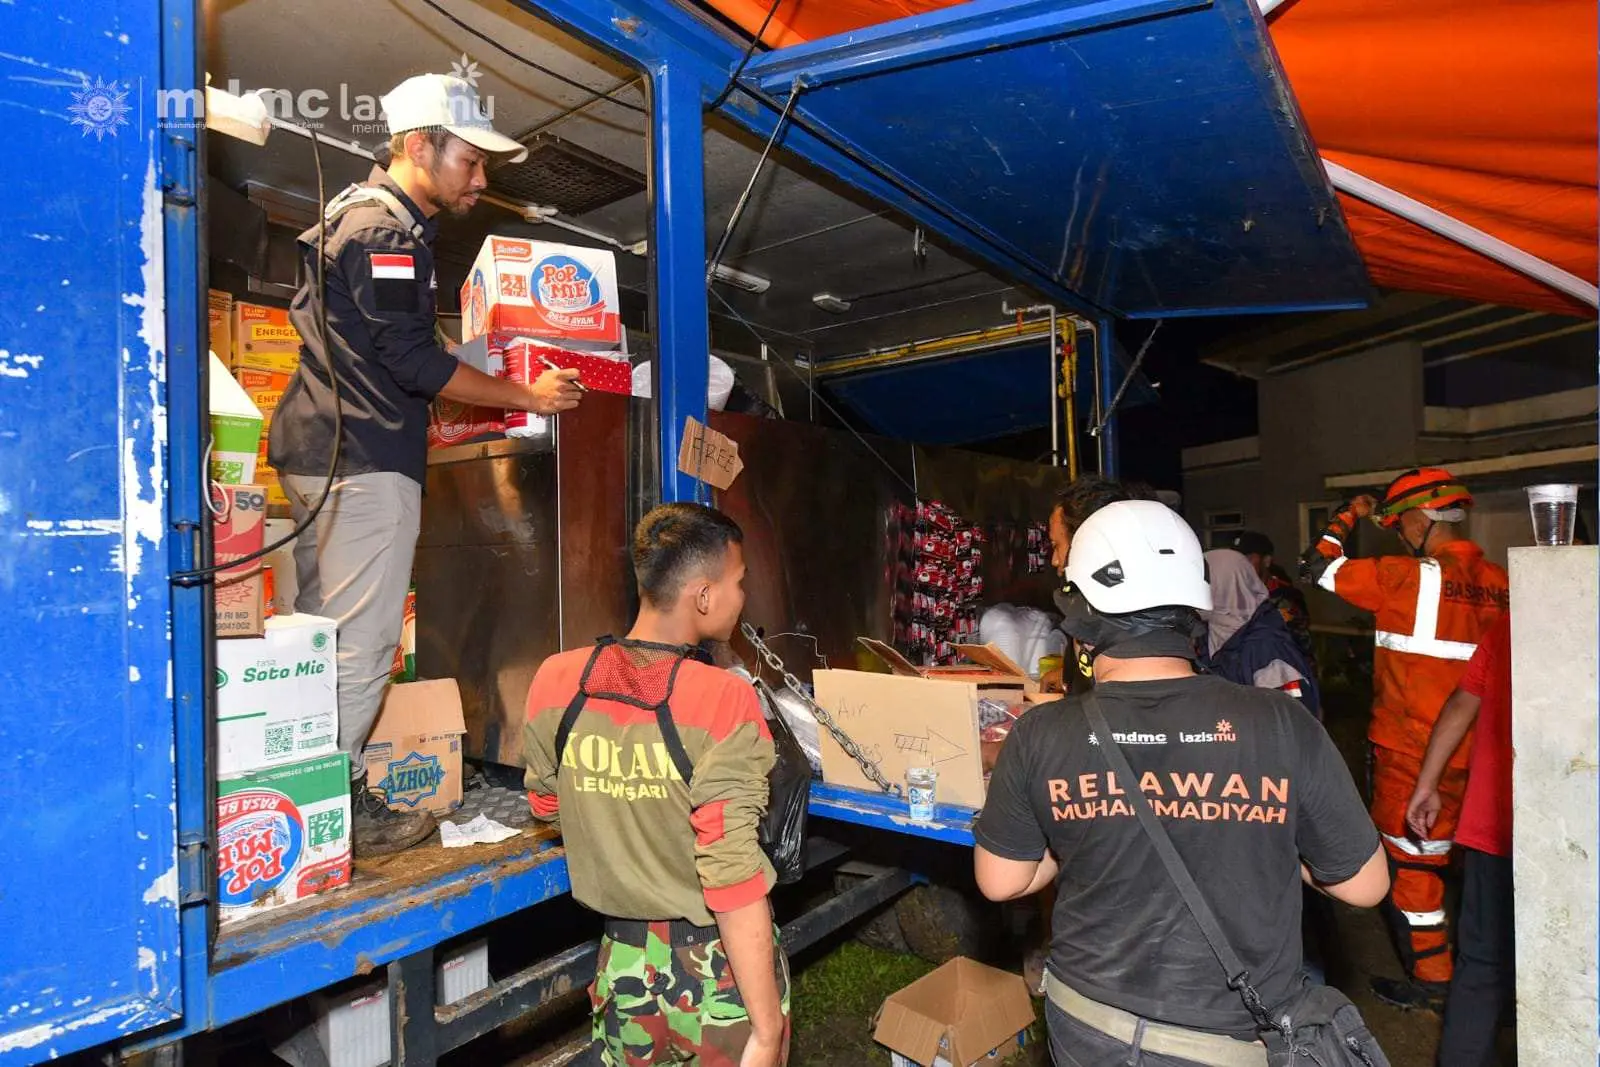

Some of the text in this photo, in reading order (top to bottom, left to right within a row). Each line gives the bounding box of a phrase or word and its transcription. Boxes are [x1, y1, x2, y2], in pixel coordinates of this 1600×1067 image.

[542, 264, 578, 284] POP
[551, 280, 587, 298] MIE
[256, 328, 298, 337] ENERGE
[693, 437, 735, 473] FREE
[243, 660, 325, 683] Soto Mie
[1112, 731, 1236, 743] mdmc lazismu
[1048, 771, 1289, 803] RELAWAN
[243, 799, 280, 811] RASA
[228, 848, 284, 895] POP
